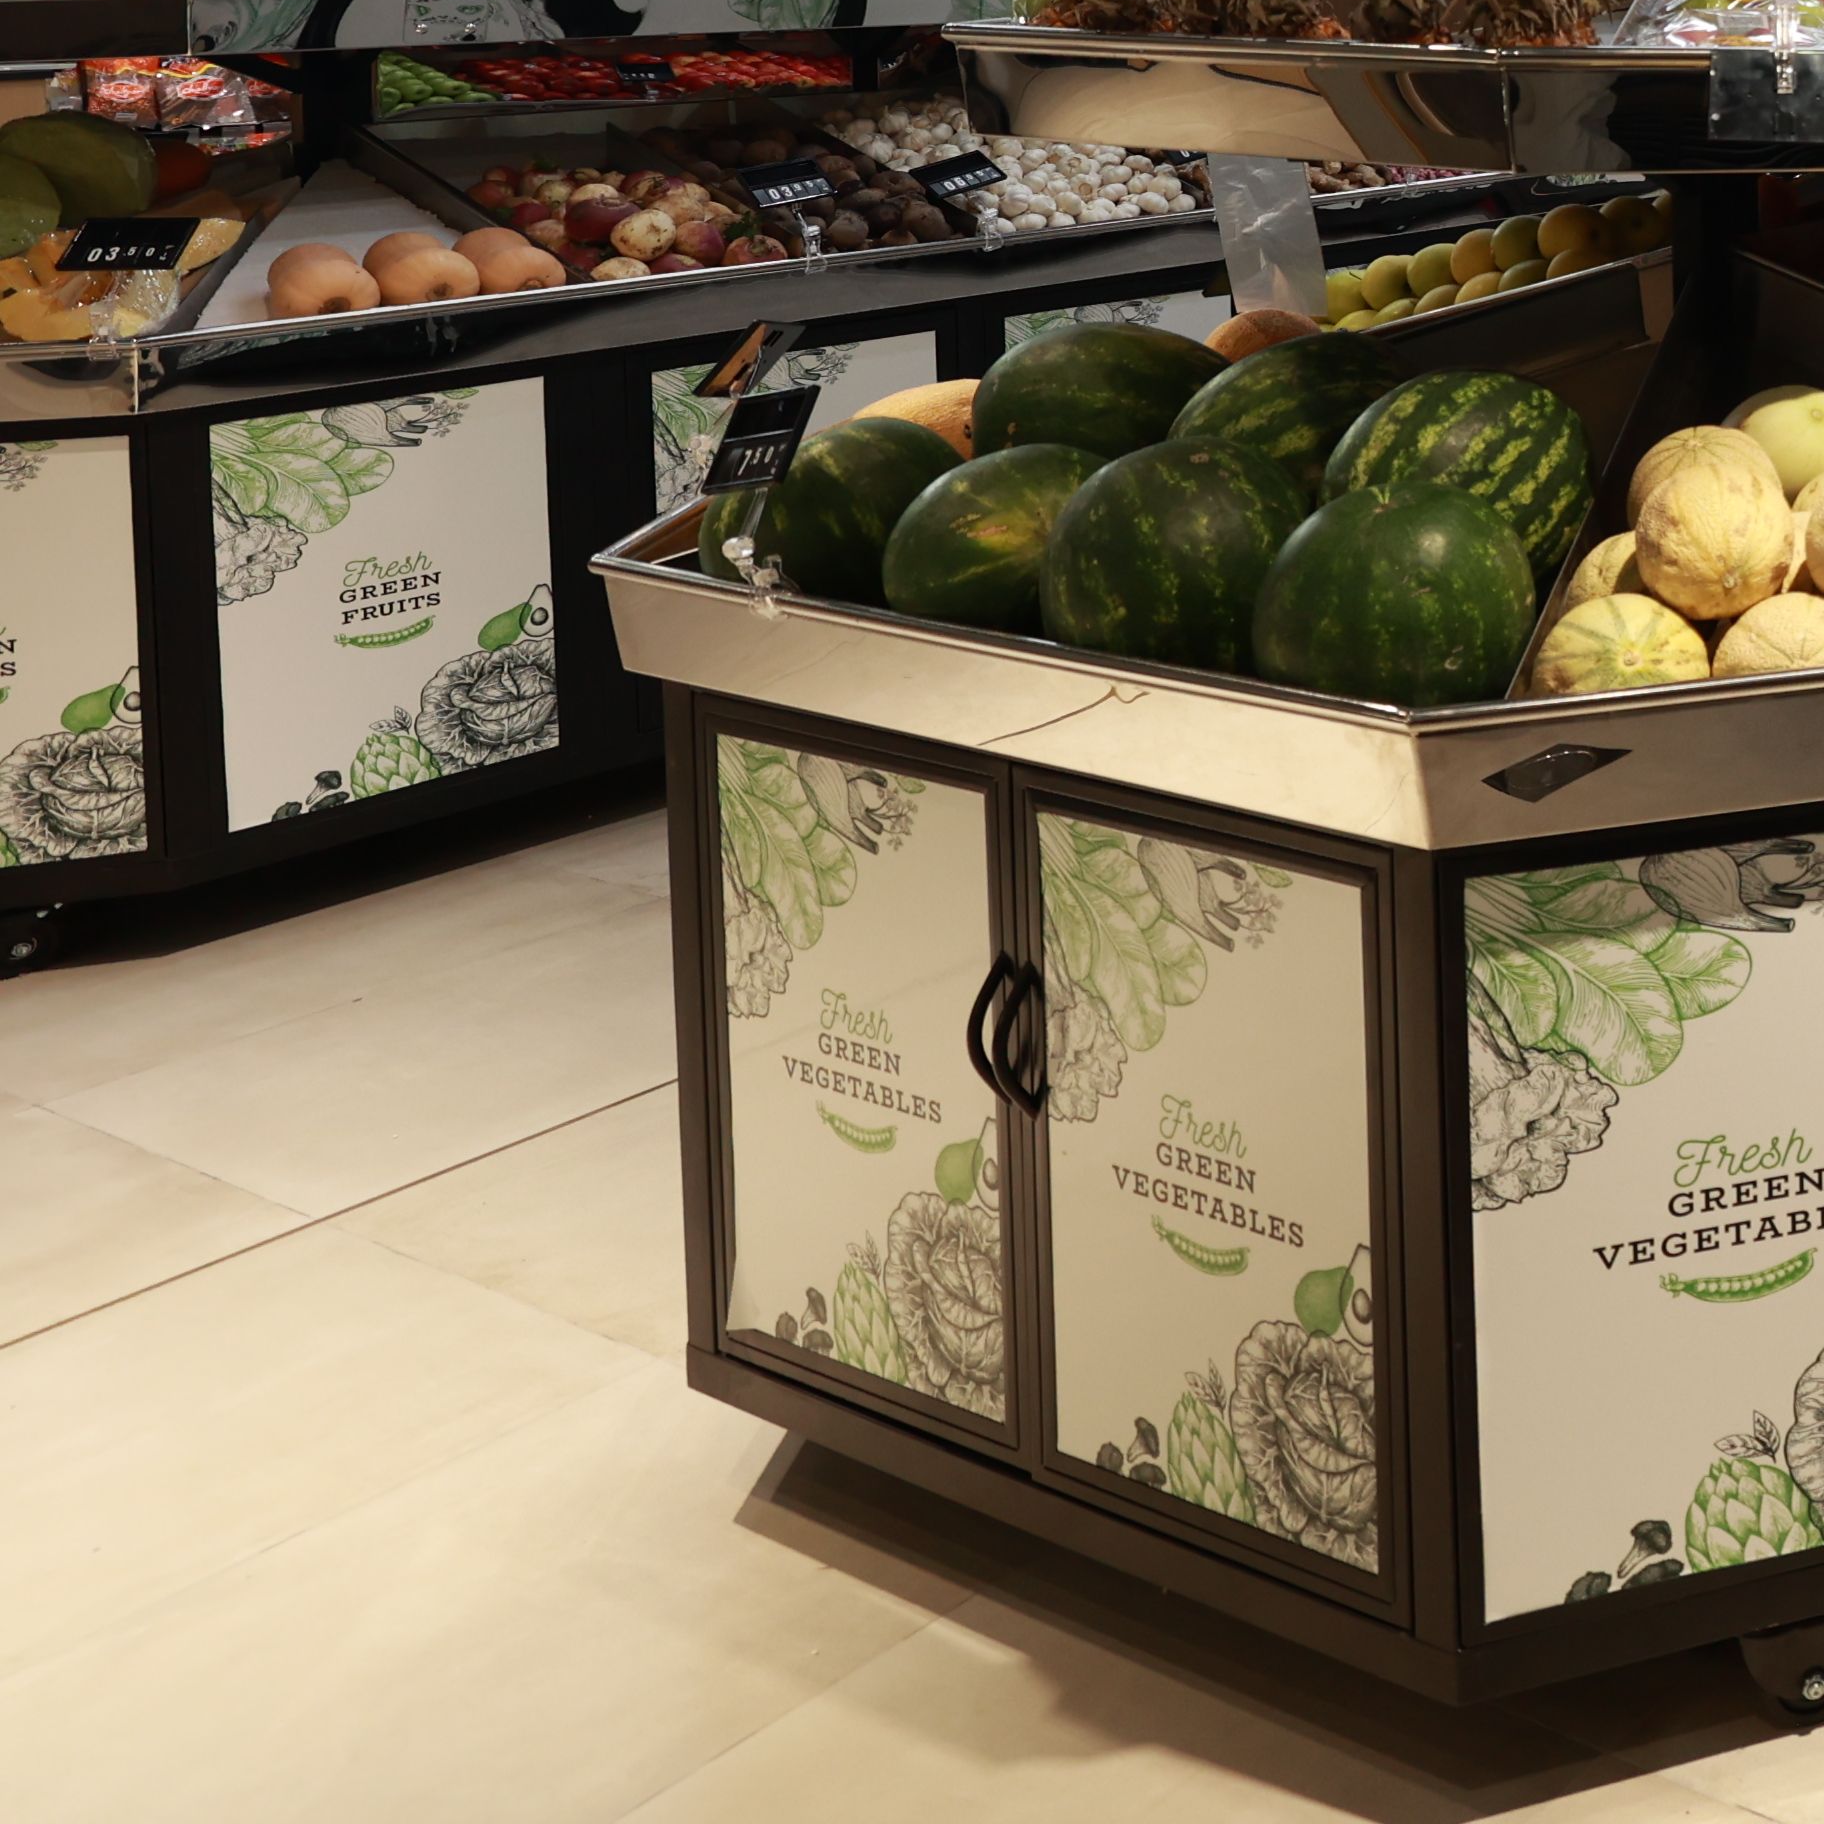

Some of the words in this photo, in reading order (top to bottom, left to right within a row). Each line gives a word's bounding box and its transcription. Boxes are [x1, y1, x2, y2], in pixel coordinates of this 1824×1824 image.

[339, 571, 442, 604] GREEN
[343, 550, 433, 588] Fresh
[342, 591, 442, 626] FRUITS
[820, 987, 894, 1045] Fresh
[818, 1032, 902, 1076] GREEN
[781, 1054, 943, 1125] VEGETABLES
[1159, 1093, 1248, 1159] Fresh
[1156, 1142, 1257, 1195] GREEN
[1672, 1127, 1814, 1189] Fresh
[1111, 1164, 1305, 1249] VEGETABLES
